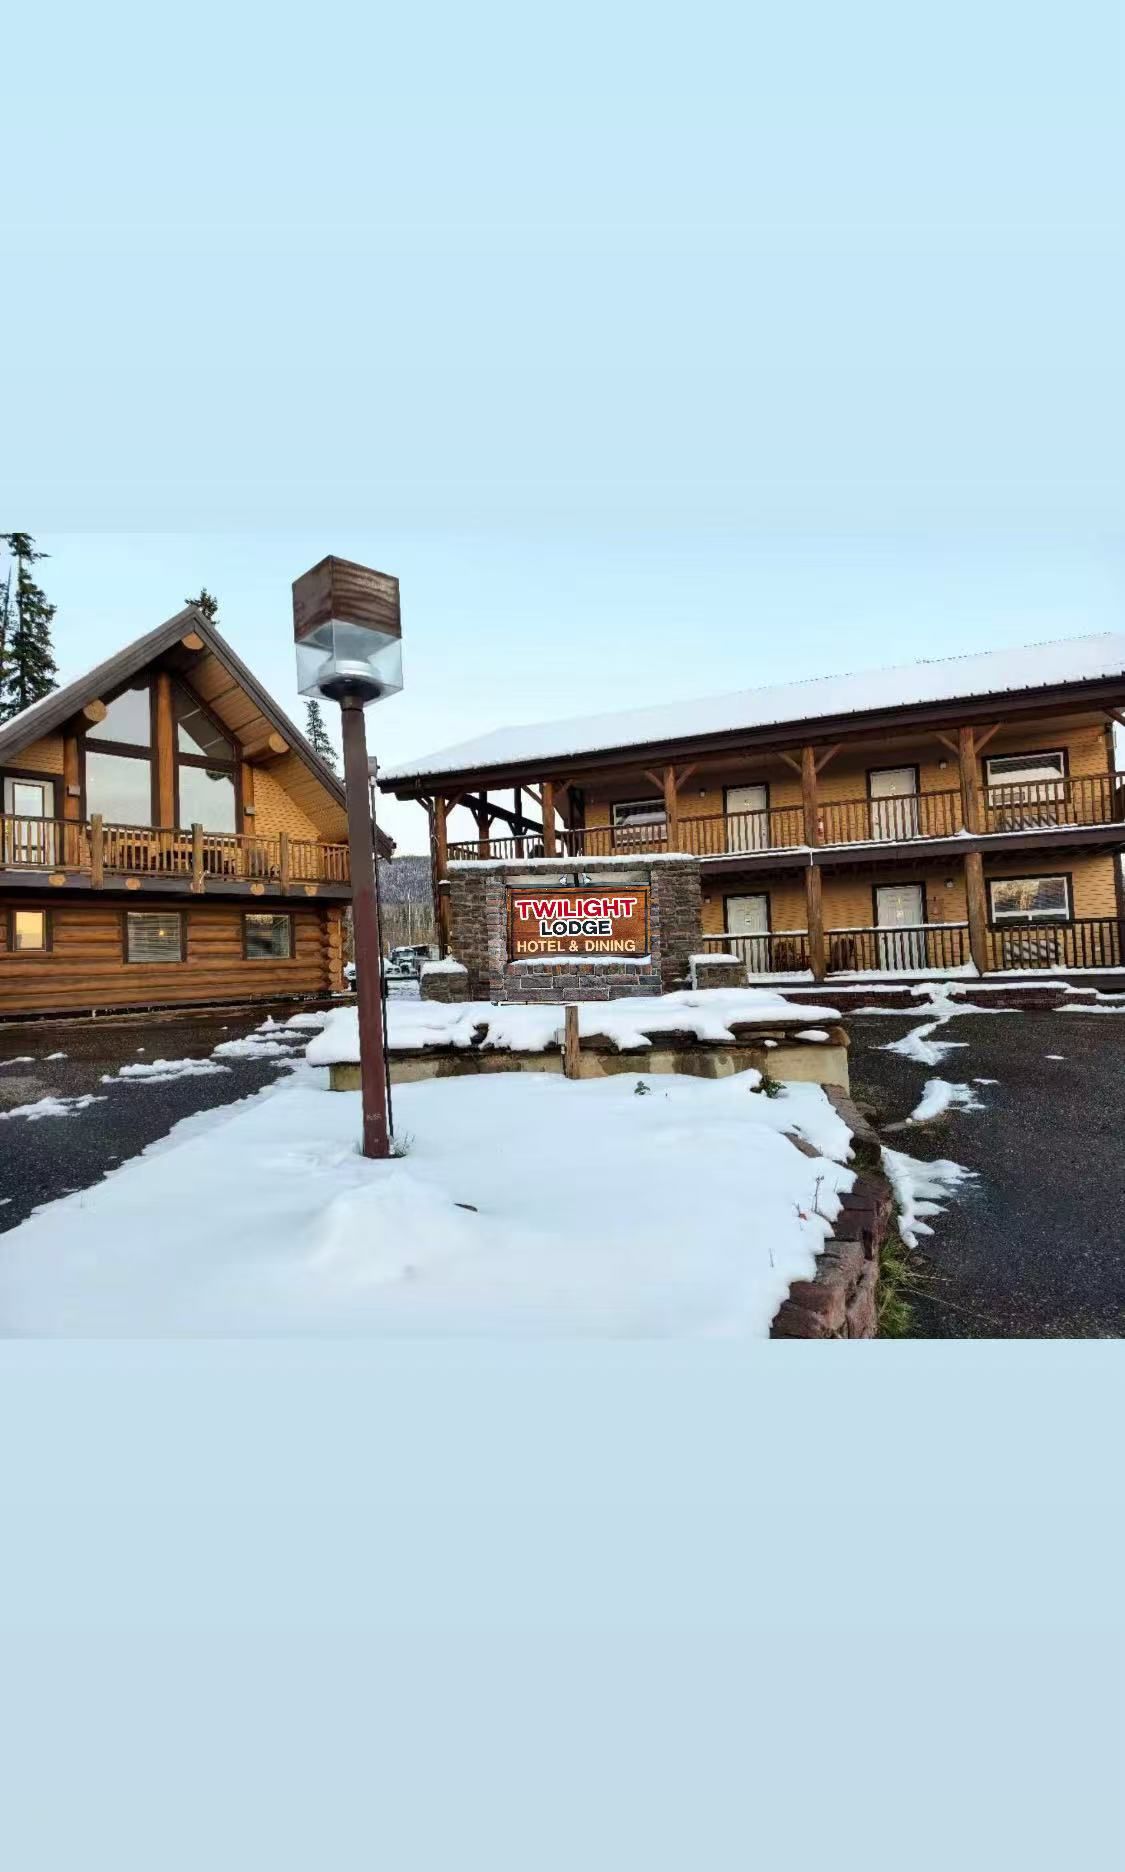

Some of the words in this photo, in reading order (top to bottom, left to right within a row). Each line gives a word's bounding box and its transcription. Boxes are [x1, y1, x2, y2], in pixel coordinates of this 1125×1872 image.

[516, 898, 637, 919] TWILIGHT
[540, 920, 612, 937] LODGE
[517, 941, 565, 952] HOTEL
[569, 940, 578, 951] &
[585, 940, 635, 952] DINING
